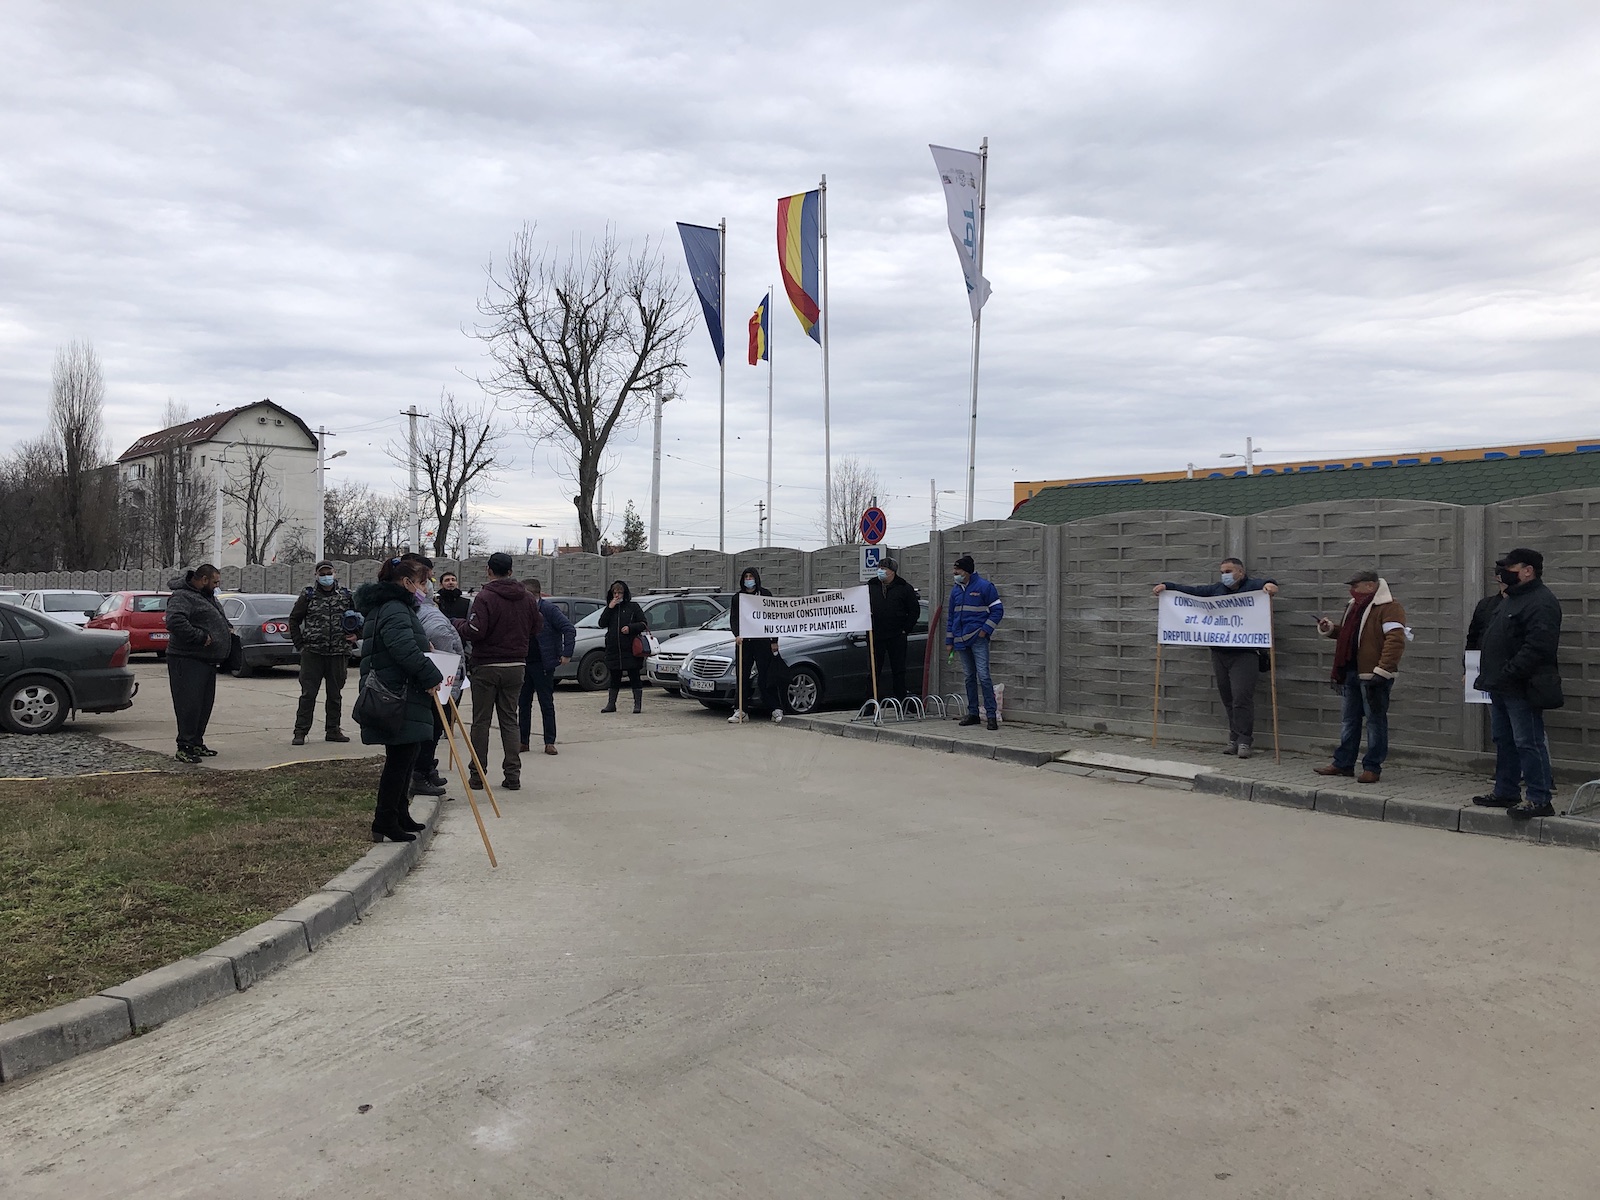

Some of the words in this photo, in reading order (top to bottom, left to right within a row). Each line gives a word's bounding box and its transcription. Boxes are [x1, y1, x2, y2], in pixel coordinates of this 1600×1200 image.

[763, 598, 789, 608] SUNTEM
[822, 592, 845, 603] LIBERI,
[1174, 596, 1216, 613] CONSTITUȚIA
[1217, 596, 1255, 609] ROMÂNIEI
[752, 611, 761, 620] CU
[763, 611, 795, 620] DREPTURI
[796, 604, 858, 618] CONSTITUȚIONALE.
[764, 625, 774, 634] NU
[775, 624, 798, 634] SCLAVI
[799, 623, 808, 632] PE
[809, 620, 847, 632] PLANTAȚIE!
[1184, 615, 1199, 625] art.
[1201, 616, 1213, 626] 40
[1163, 630, 1192, 642] DREPTUL
[1193, 632, 1202, 642] LA
[1203, 631, 1230, 643] LIBERĂ
[1231, 633, 1270, 644] ASOCIERE!
